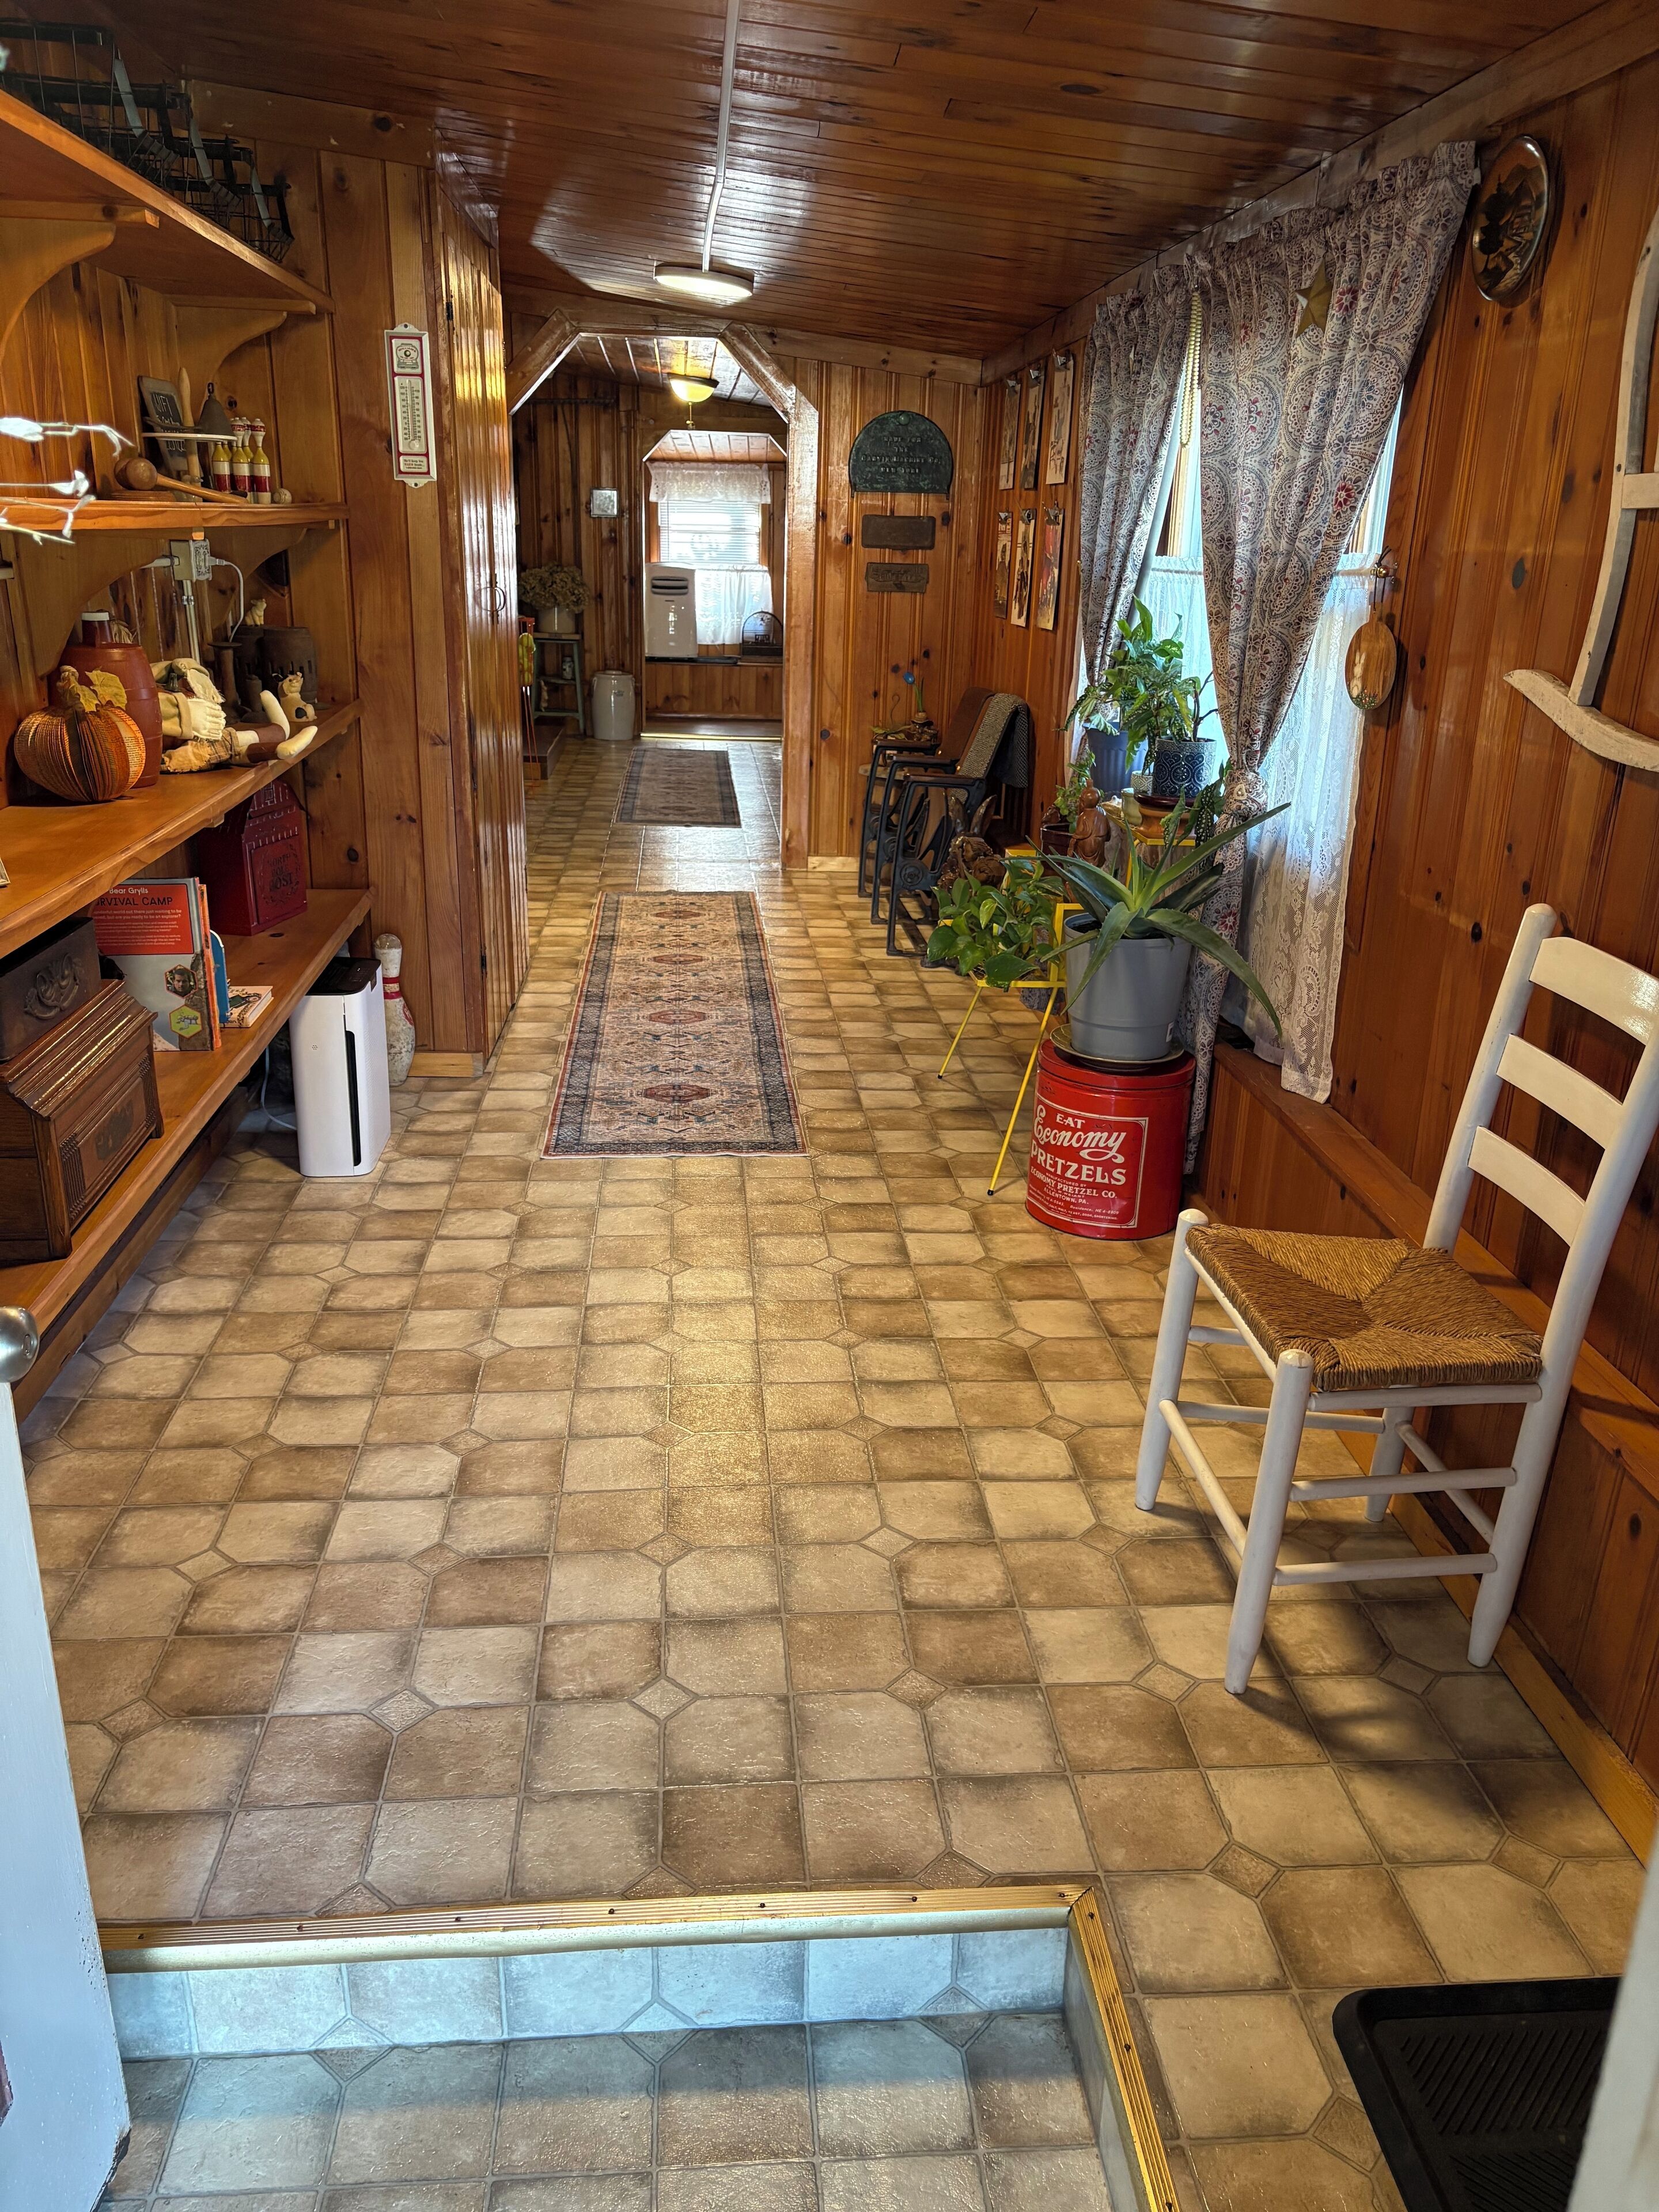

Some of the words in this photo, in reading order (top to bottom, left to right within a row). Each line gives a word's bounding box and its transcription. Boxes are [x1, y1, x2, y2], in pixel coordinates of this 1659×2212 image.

[128, 887, 149, 895] Grylls
[142, 897, 173, 906] CAMP
[1056, 1113, 1085, 1129] EAT
[1033, 1104, 1127, 1164] Economy
[1031, 1139, 1126, 1185] PRETZELS
[1031, 1166, 1056, 1188] ECONOMY
[1057, 1183, 1099, 1196] PRETZEL
[1101, 1190, 1118, 1198] CO.
[1046, 1172, 1078, 1187] MANUFACTURED
